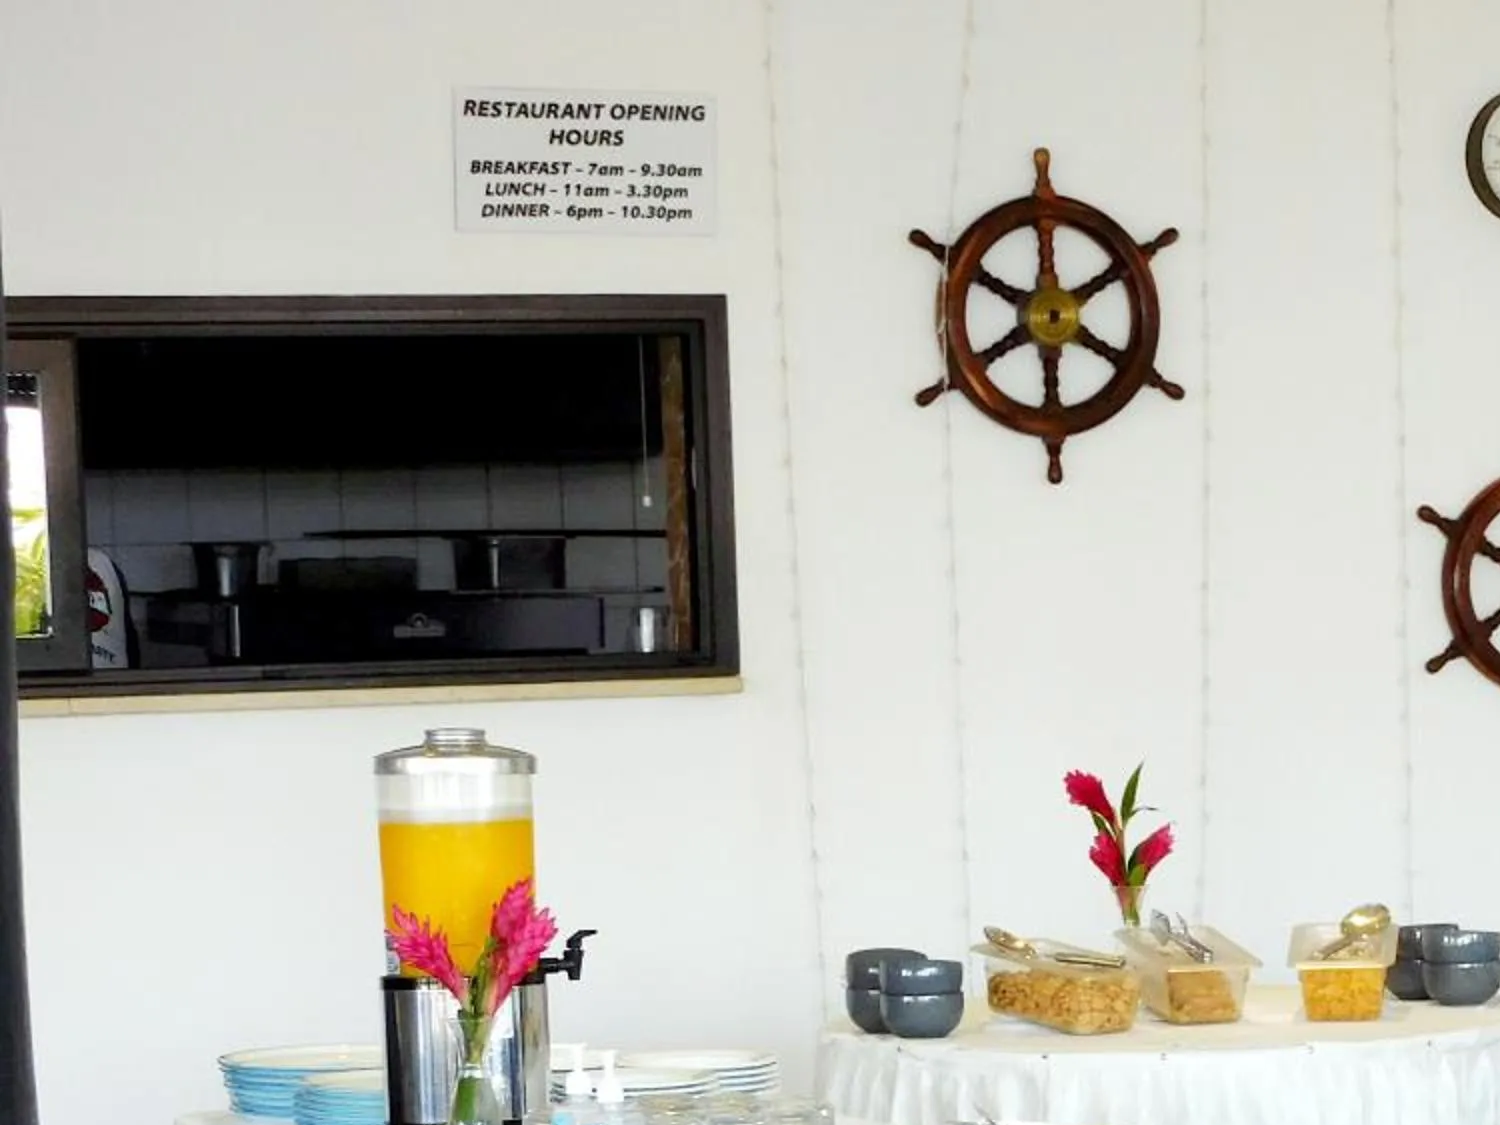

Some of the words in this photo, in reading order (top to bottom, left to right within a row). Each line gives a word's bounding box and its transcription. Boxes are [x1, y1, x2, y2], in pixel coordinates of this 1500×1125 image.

[463, 99, 605, 120] RESTAURANT
[610, 103, 705, 121] OPENING
[549, 129, 624, 146] HOURS
[470, 160, 572, 175] BREAKFAST
[588, 163, 624, 176] 7am
[641, 164, 702, 177] 9.30am
[485, 182, 546, 197] LUNCH
[564, 184, 609, 198] 11am
[627, 184, 688, 201] 3.30pm
[481, 203, 550, 218] DINNER
[566, 205, 603, 220] 6pm
[622, 206, 692, 222] 10.30pm
